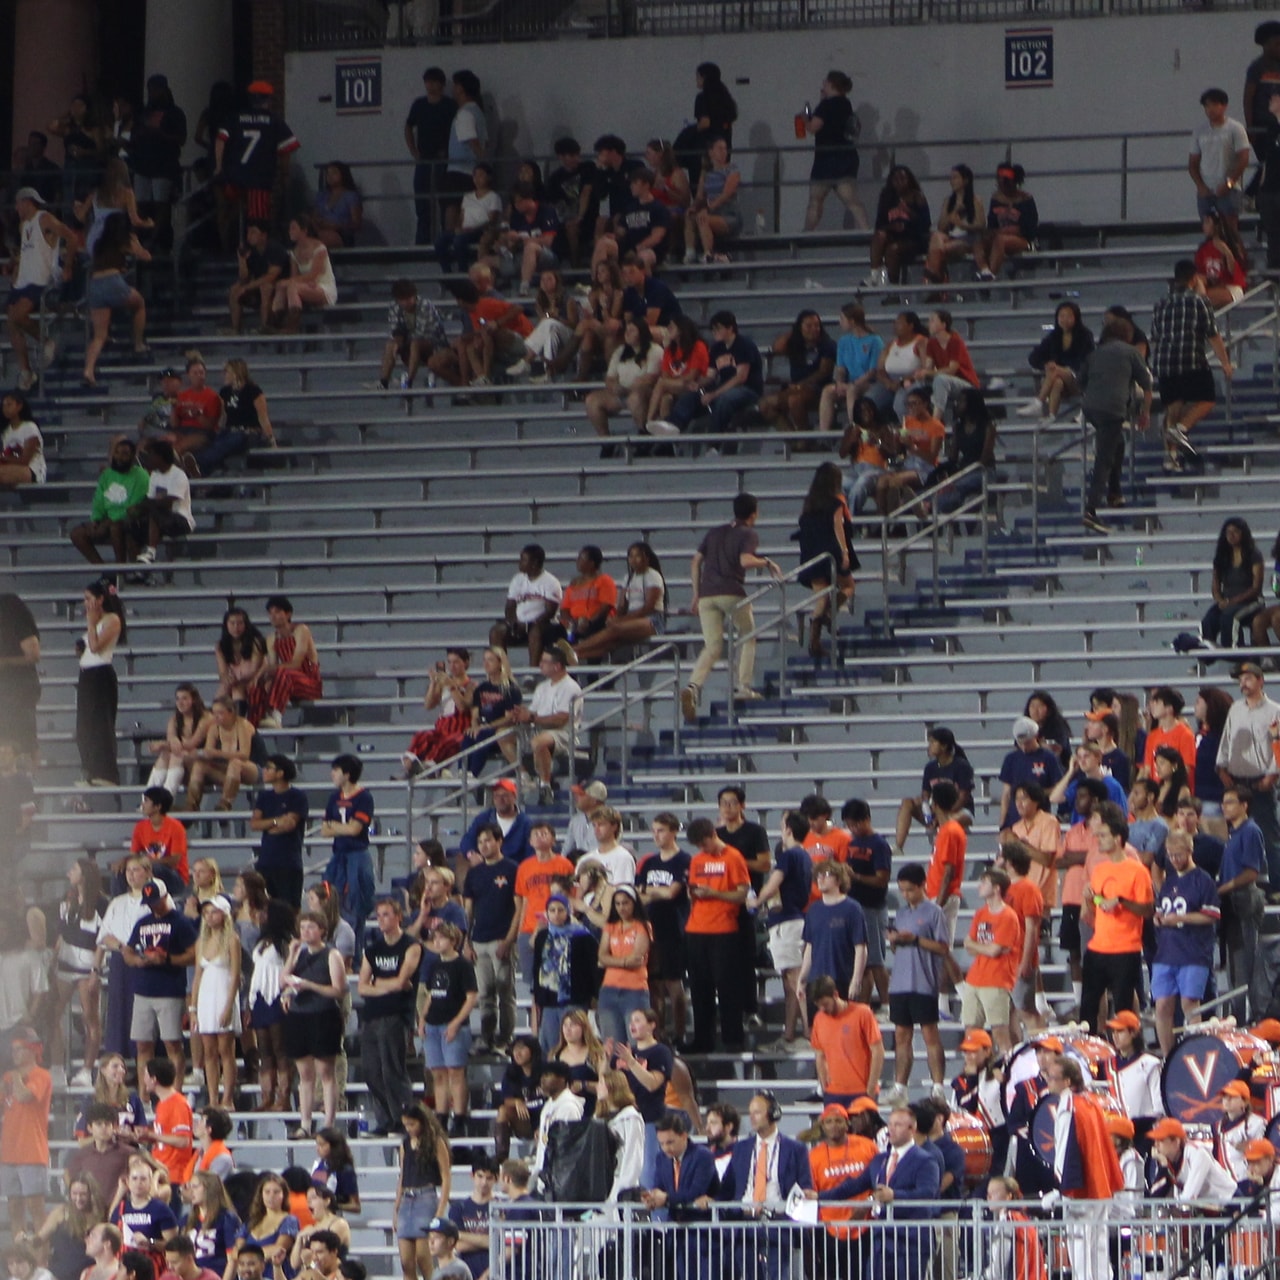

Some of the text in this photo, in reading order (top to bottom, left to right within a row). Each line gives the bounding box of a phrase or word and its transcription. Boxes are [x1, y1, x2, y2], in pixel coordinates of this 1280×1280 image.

[1010, 40, 1048, 50] SECTION
[341, 67, 377, 77] SECTION
[1009, 51, 1047, 77] 102
[345, 79, 374, 104] 101
[240, 129, 262, 164] 7
[1182, 1051, 1219, 1099] V
